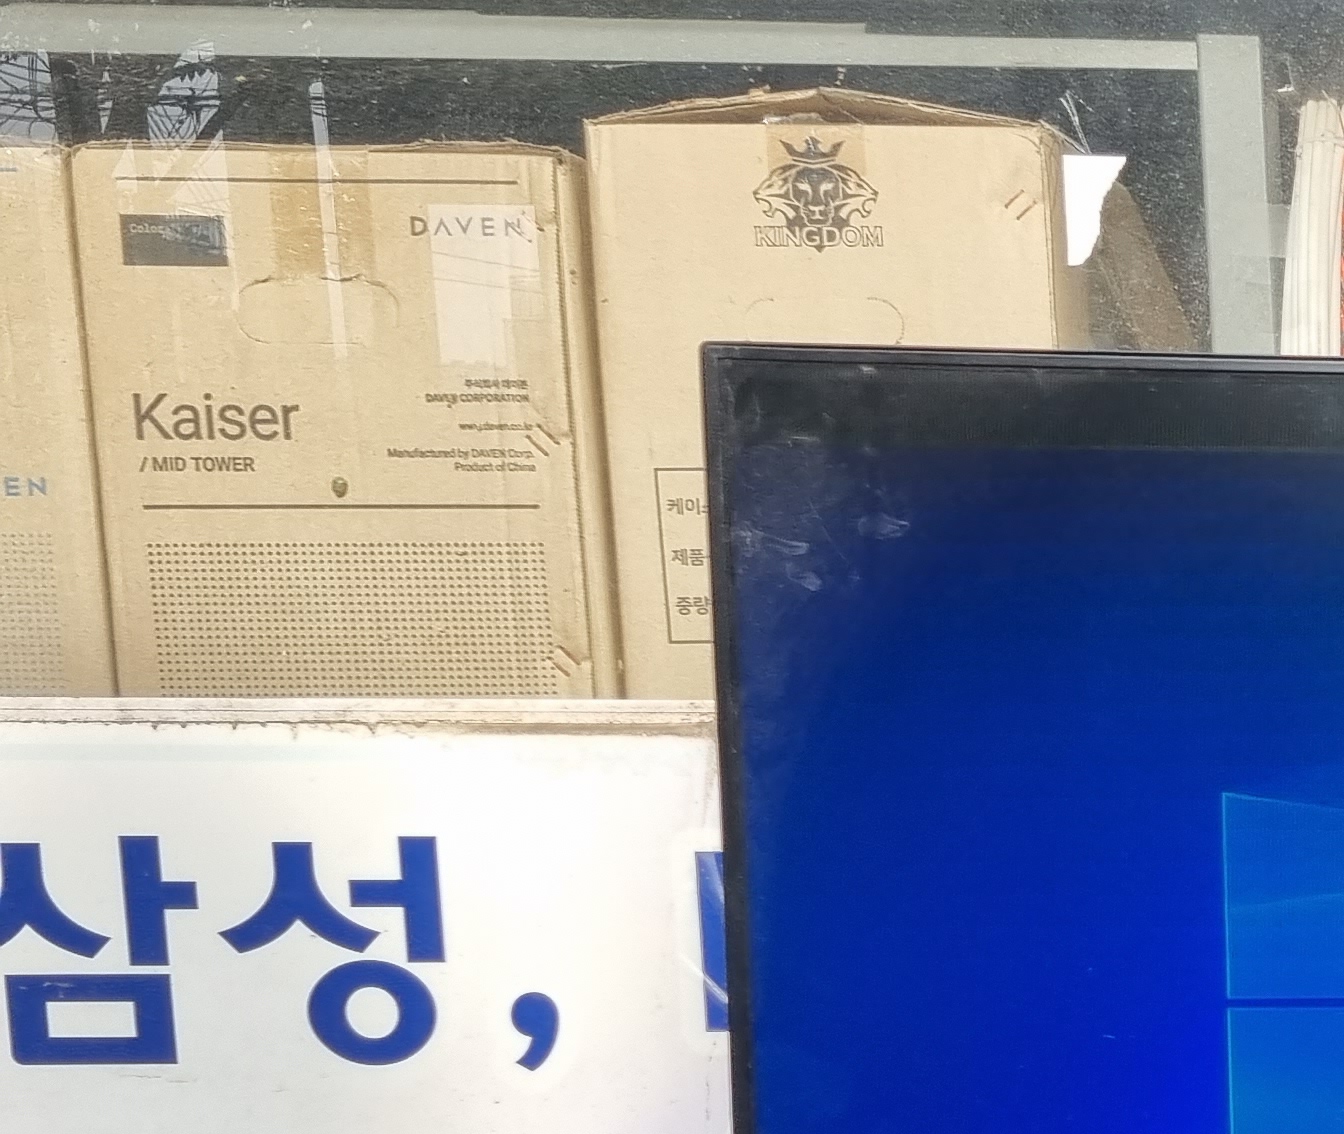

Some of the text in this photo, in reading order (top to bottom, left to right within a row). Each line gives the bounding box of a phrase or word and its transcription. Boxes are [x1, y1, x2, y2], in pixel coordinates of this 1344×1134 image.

[410, 216, 521, 236] DAVEN
[753, 225, 884, 248] KINGDOM
[459, 393, 530, 403] CORPORATION
[132, 392, 299, 441] Kaiser
[387, 448, 456, 459] Manufactured
[457, 448, 470, 461] by
[152, 456, 187, 472] MID
[191, 456, 256, 472] TOWER
[454, 461, 537, 473] Product of China
[0, 836, 559, 1071] 삼성,
